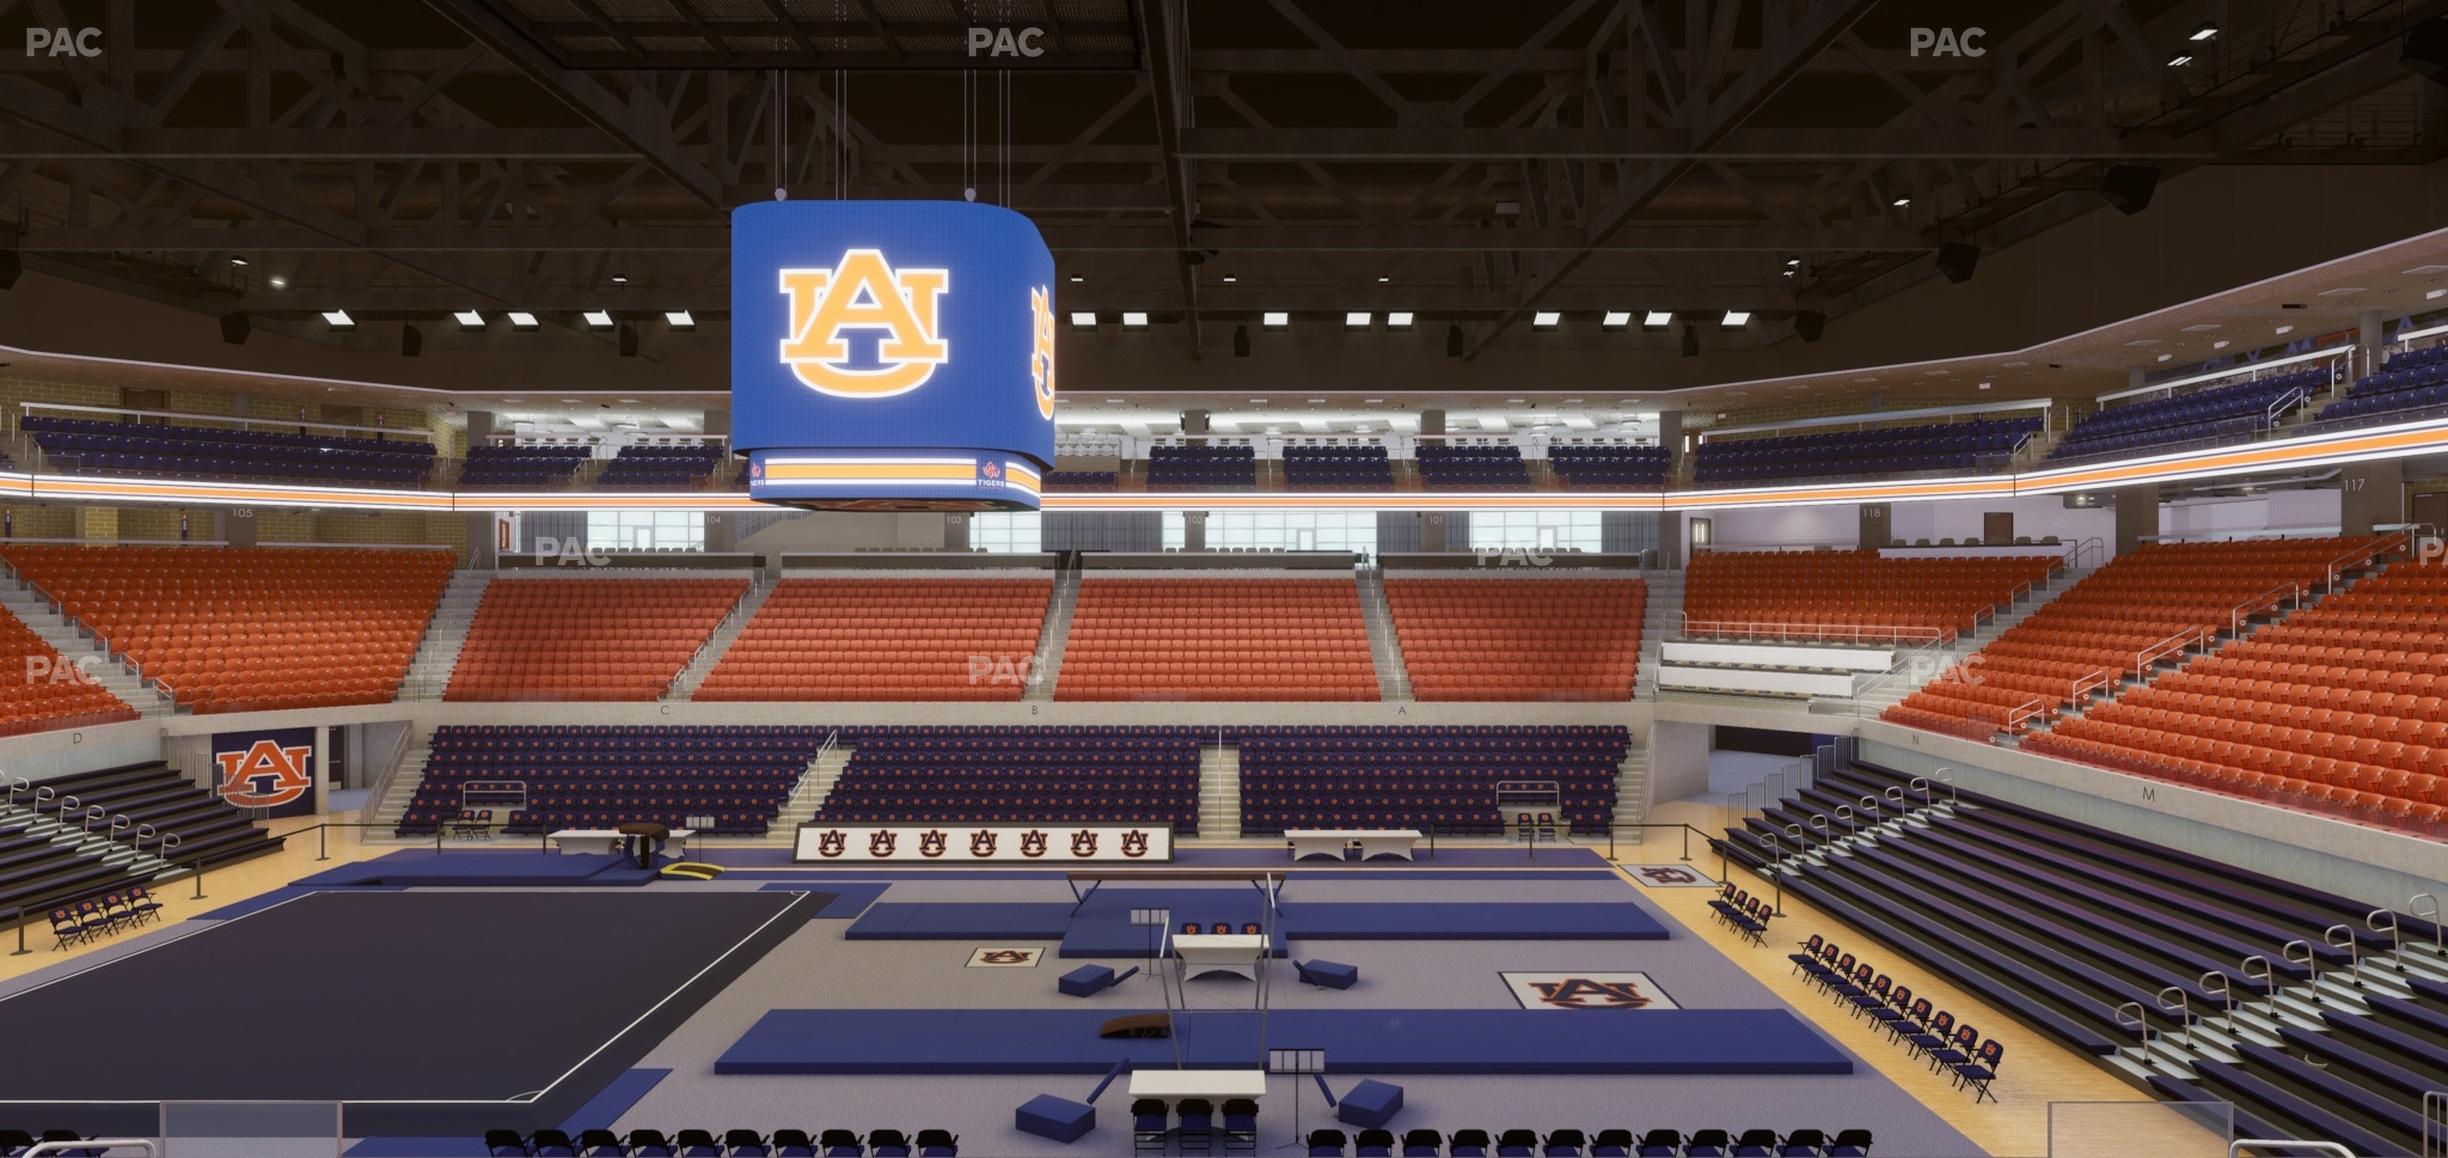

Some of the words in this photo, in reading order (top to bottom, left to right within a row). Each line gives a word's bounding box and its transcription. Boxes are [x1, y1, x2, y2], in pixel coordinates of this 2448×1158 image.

[978, 479, 1005, 487] TIGERS
[2344, 478, 2366, 492] 117
[232, 508, 253, 518] 105
[1863, 507, 1881, 518] 118
[706, 515, 721, 525] 104
[947, 515, 962, 525] 103
[1188, 515, 1203, 525] 102
[1430, 515, 1443, 525] 101
[660, 704, 671, 716] C
[1031, 704, 1039, 716] B
[1398, 705, 1407, 715] A
[73, 732, 82, 745] D
[2142, 785, 2156, 802] M
